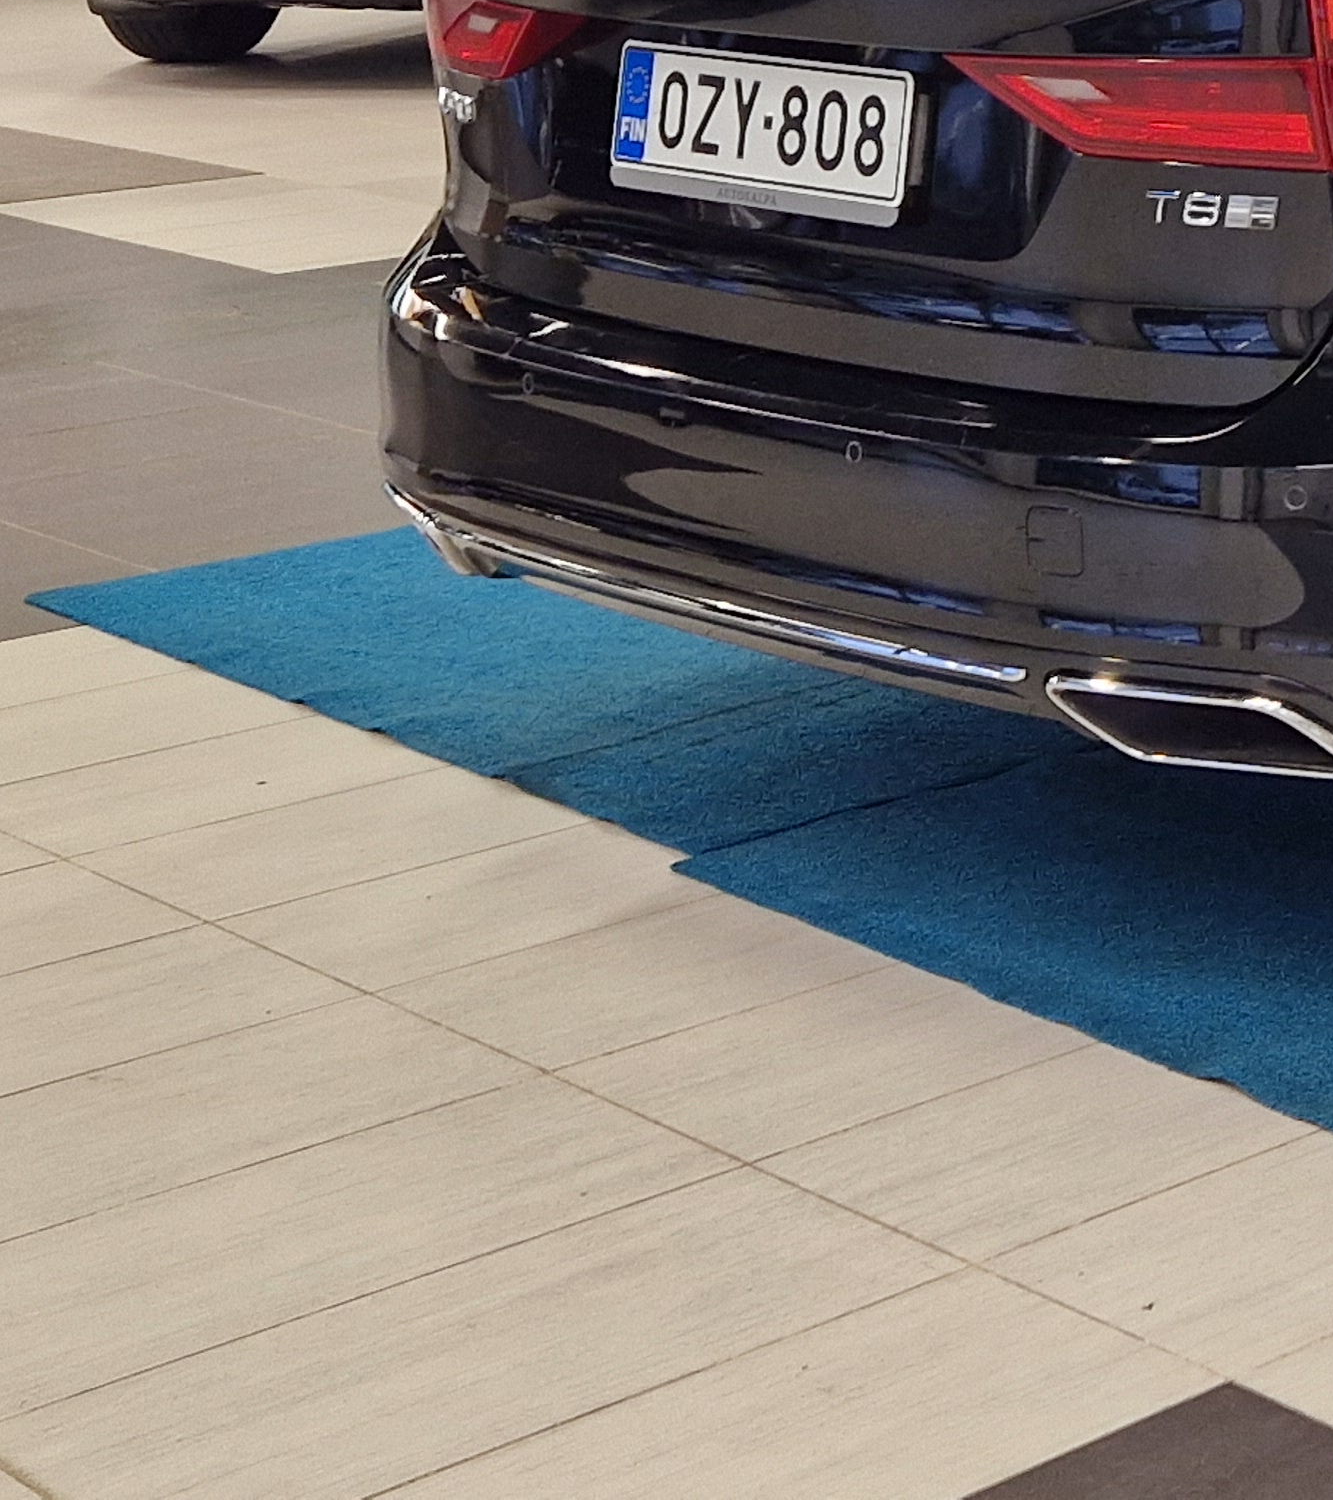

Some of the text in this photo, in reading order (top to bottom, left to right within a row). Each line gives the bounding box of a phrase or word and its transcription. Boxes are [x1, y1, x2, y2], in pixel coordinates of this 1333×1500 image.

[620, 115, 646, 142] FIN
[659, 71, 885, 176] OZY-808
[1145, 190, 1221, 227] T8
